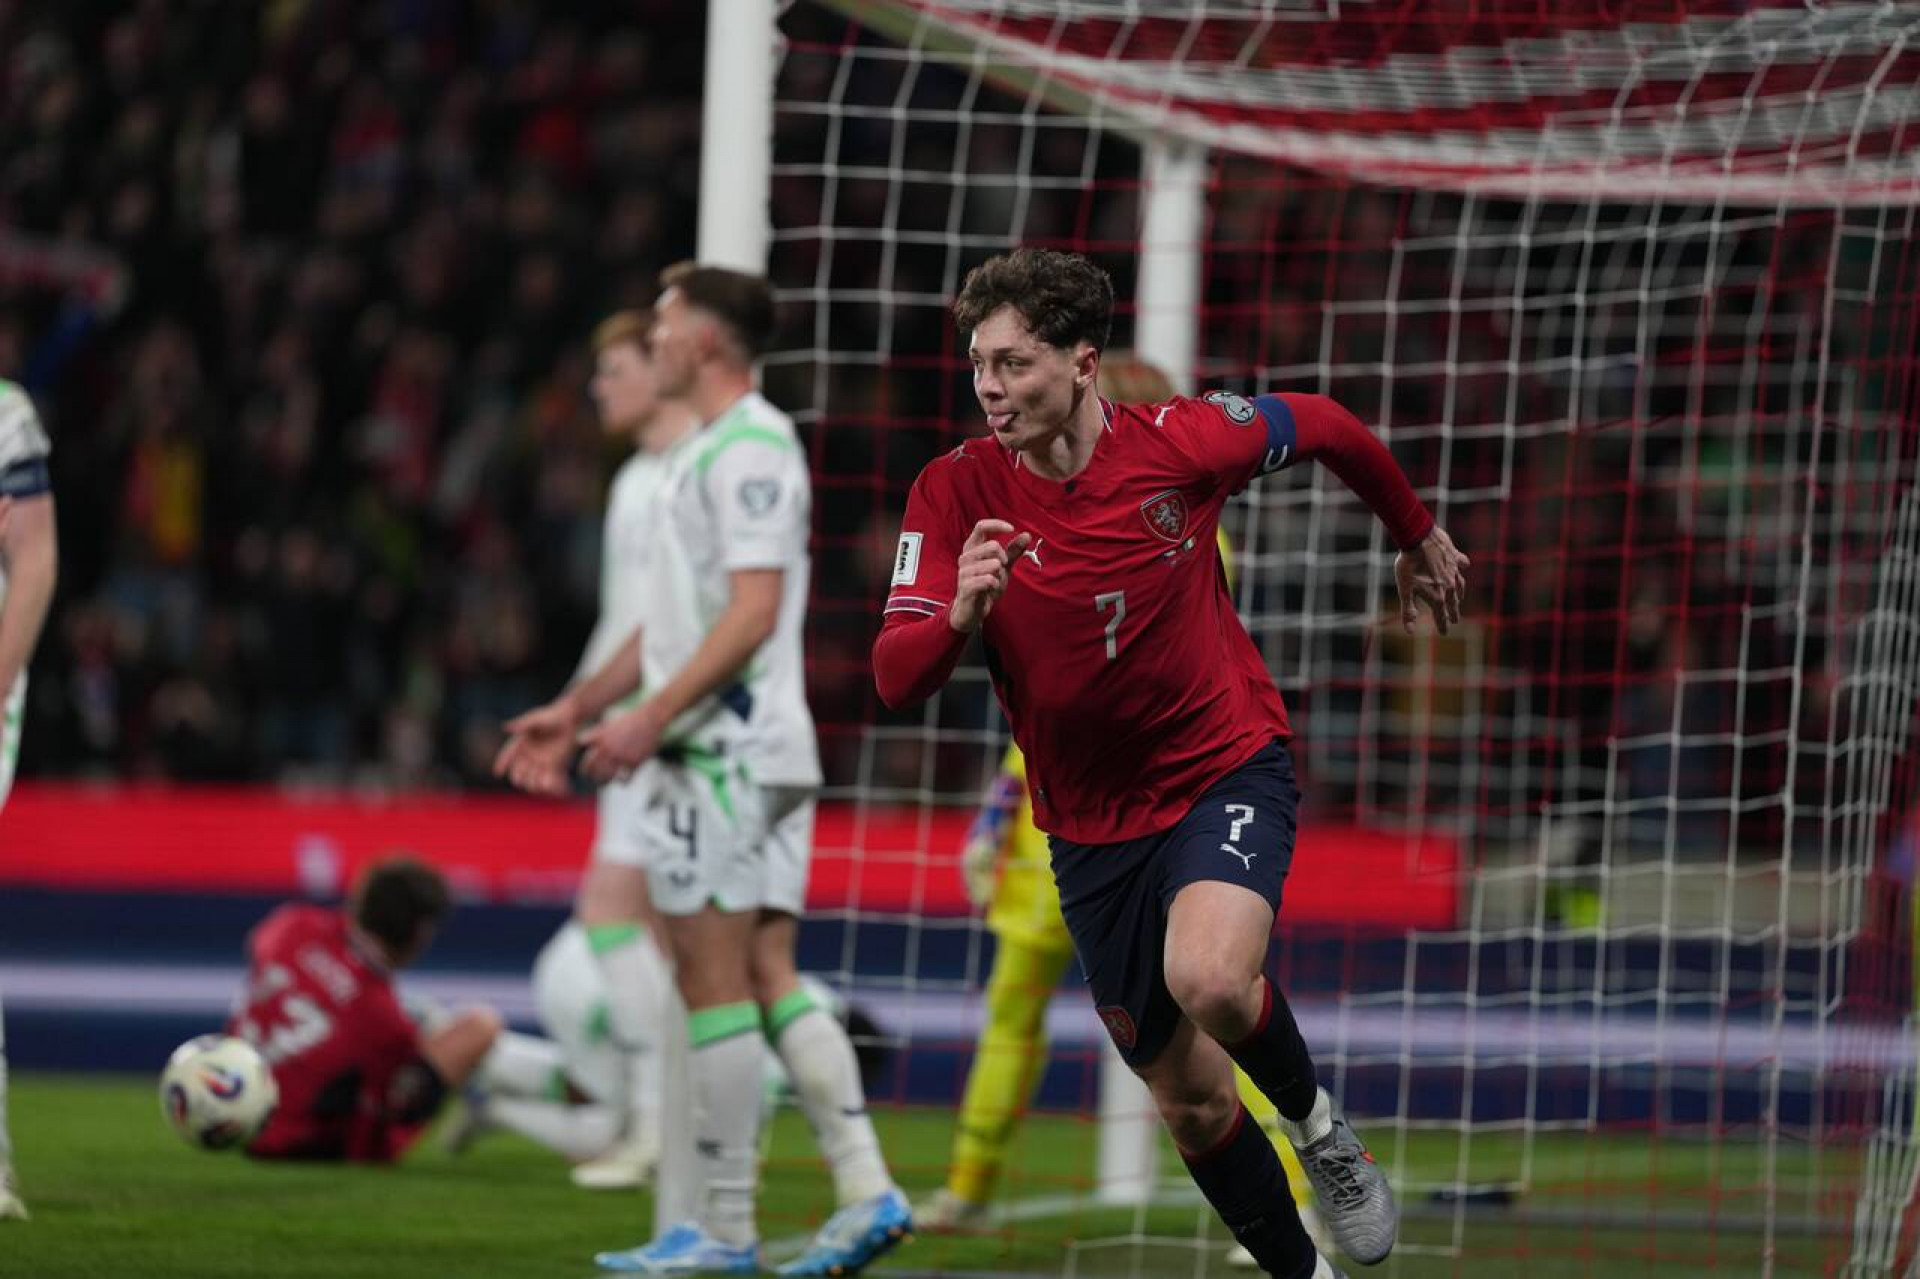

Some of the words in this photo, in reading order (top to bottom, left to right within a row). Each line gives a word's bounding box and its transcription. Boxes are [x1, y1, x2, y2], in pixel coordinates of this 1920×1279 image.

[1094, 590, 1125, 659] 7
[668, 803, 698, 860] 4
[1225, 803, 1254, 841] 7
